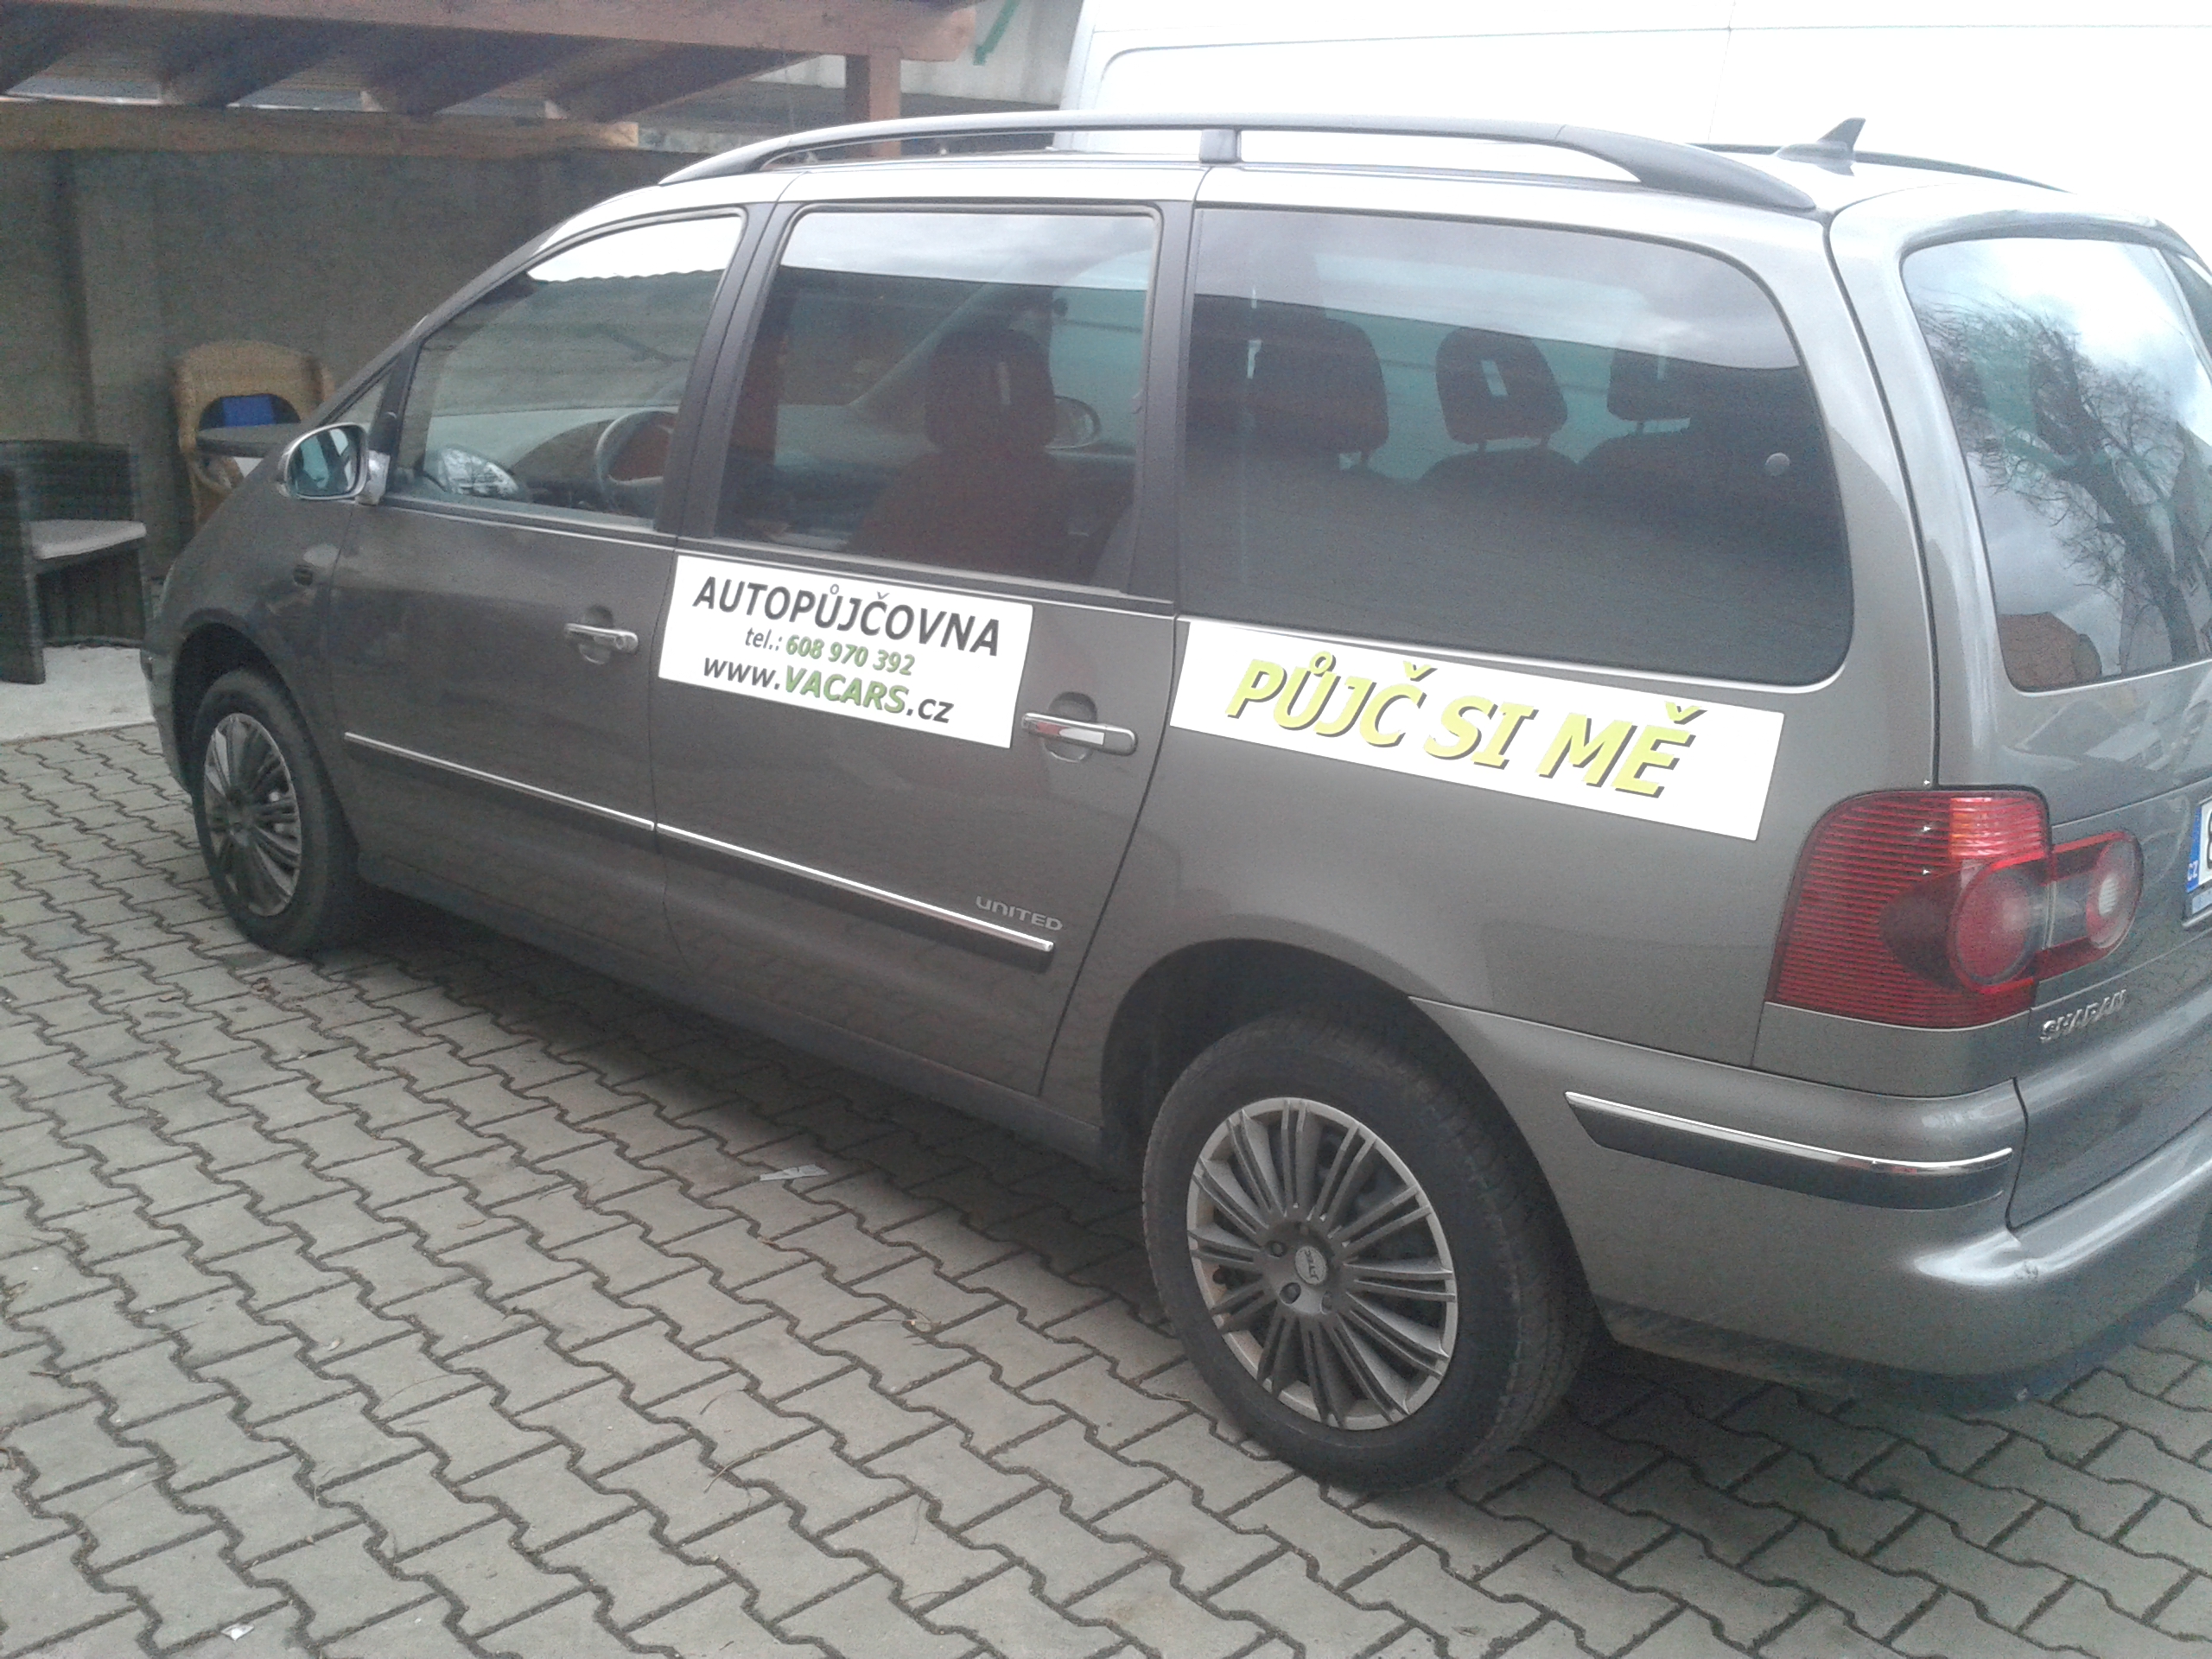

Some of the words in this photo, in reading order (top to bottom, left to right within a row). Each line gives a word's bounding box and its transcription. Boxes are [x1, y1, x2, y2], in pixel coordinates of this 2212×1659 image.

[692, 576, 1000, 657] AUTOPŮJČOVNA
[745, 627, 784, 652] tel.:
[785, 634, 824, 660] 608
[828, 642, 868, 668] 970
[872, 649, 916, 677] 392
[703, 657, 955, 723] www.VACARS.cz
[1225, 651, 1438, 748] PŮJČ
[1422, 696, 1540, 771] SI
[1535, 702, 1708, 799] MĚ
[976, 895, 1064, 931] UNITED
